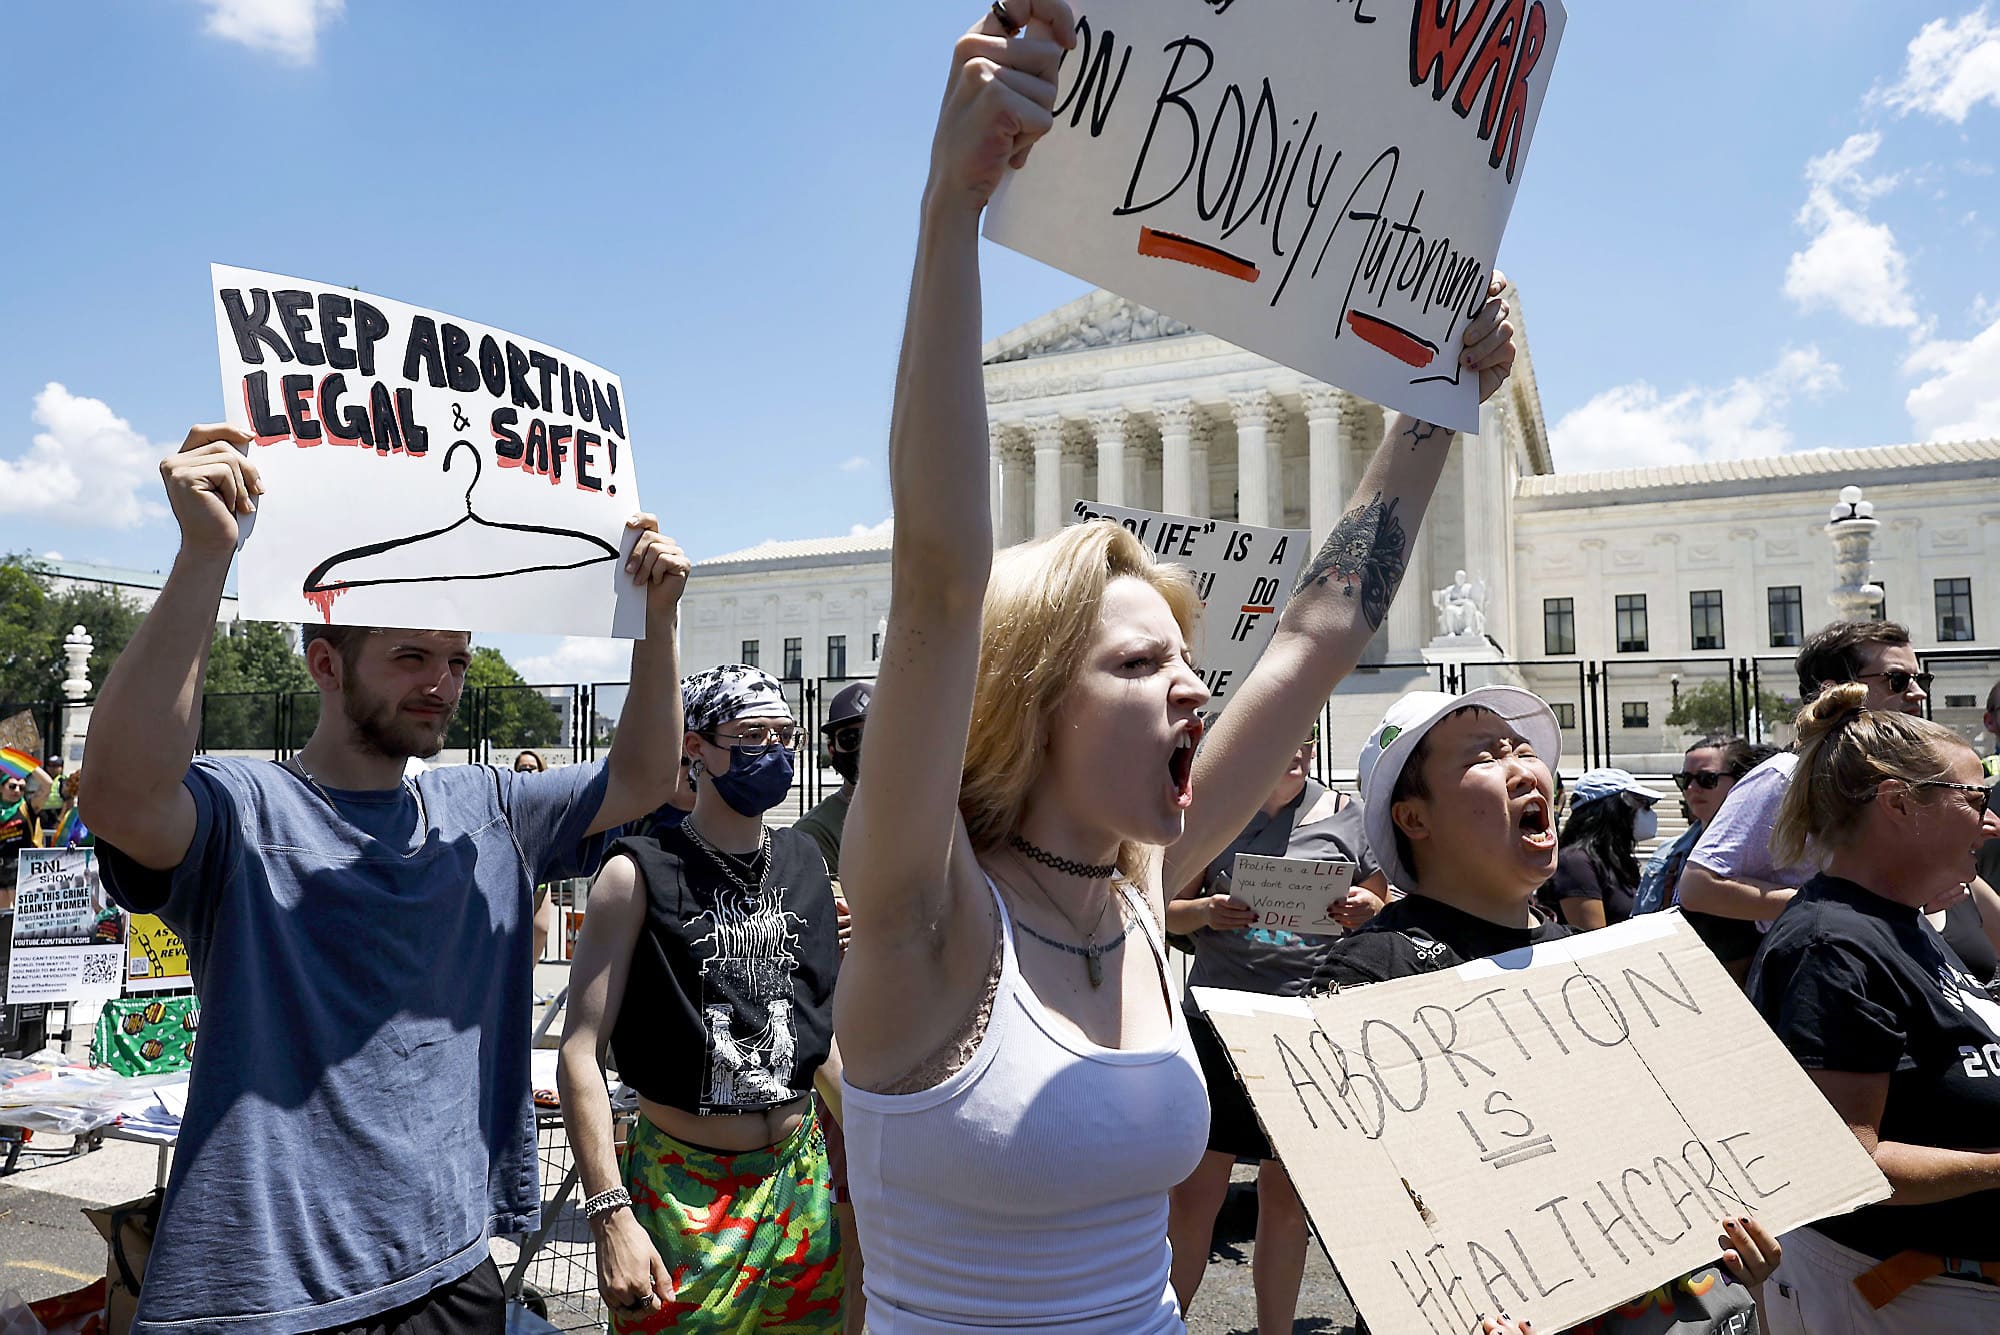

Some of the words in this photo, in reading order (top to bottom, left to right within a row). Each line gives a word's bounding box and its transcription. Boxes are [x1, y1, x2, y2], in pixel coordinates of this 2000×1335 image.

[1409, 0, 1546, 184] WAR
[220, 288, 389, 376] KEEP
[403, 315, 625, 440] ABORTION
[243, 370, 428, 456] LEGAL
[452, 403, 471, 431] &
[491, 407, 618, 496] SAFE!
[1223, 530, 1252, 562] IS
[1268, 536, 1289, 565] A
[1248, 577, 1280, 606] DO
[1231, 614, 1260, 642] IF
[31, 860, 67, 875] RNL
[1284, 863, 1293, 873] is
[1301, 866, 1308, 874] a
[1314, 862, 1347, 876] LIE
[40, 873, 75, 884] SHOW
[1239, 879, 1255, 891] you
[1261, 879, 1282, 889] don't
[1320, 883, 1334, 891] if
[18, 893, 39, 904] STOP
[42, 891, 60, 901] THIS
[63, 888, 89, 899] CRIME
[1252, 896, 1305, 910] Women
[18, 902, 53, 915] AGAINST
[56, 898, 90, 911] WOMEN!
[1264, 911, 1302, 928] DIE
[154, 928, 169, 937] AS
[166, 937, 183, 947] FO
[1273, 951, 1702, 1140] ABORTION
[1457, 1090, 1534, 1153] IS
[1390, 1131, 1791, 1335] HEALTHCARE
